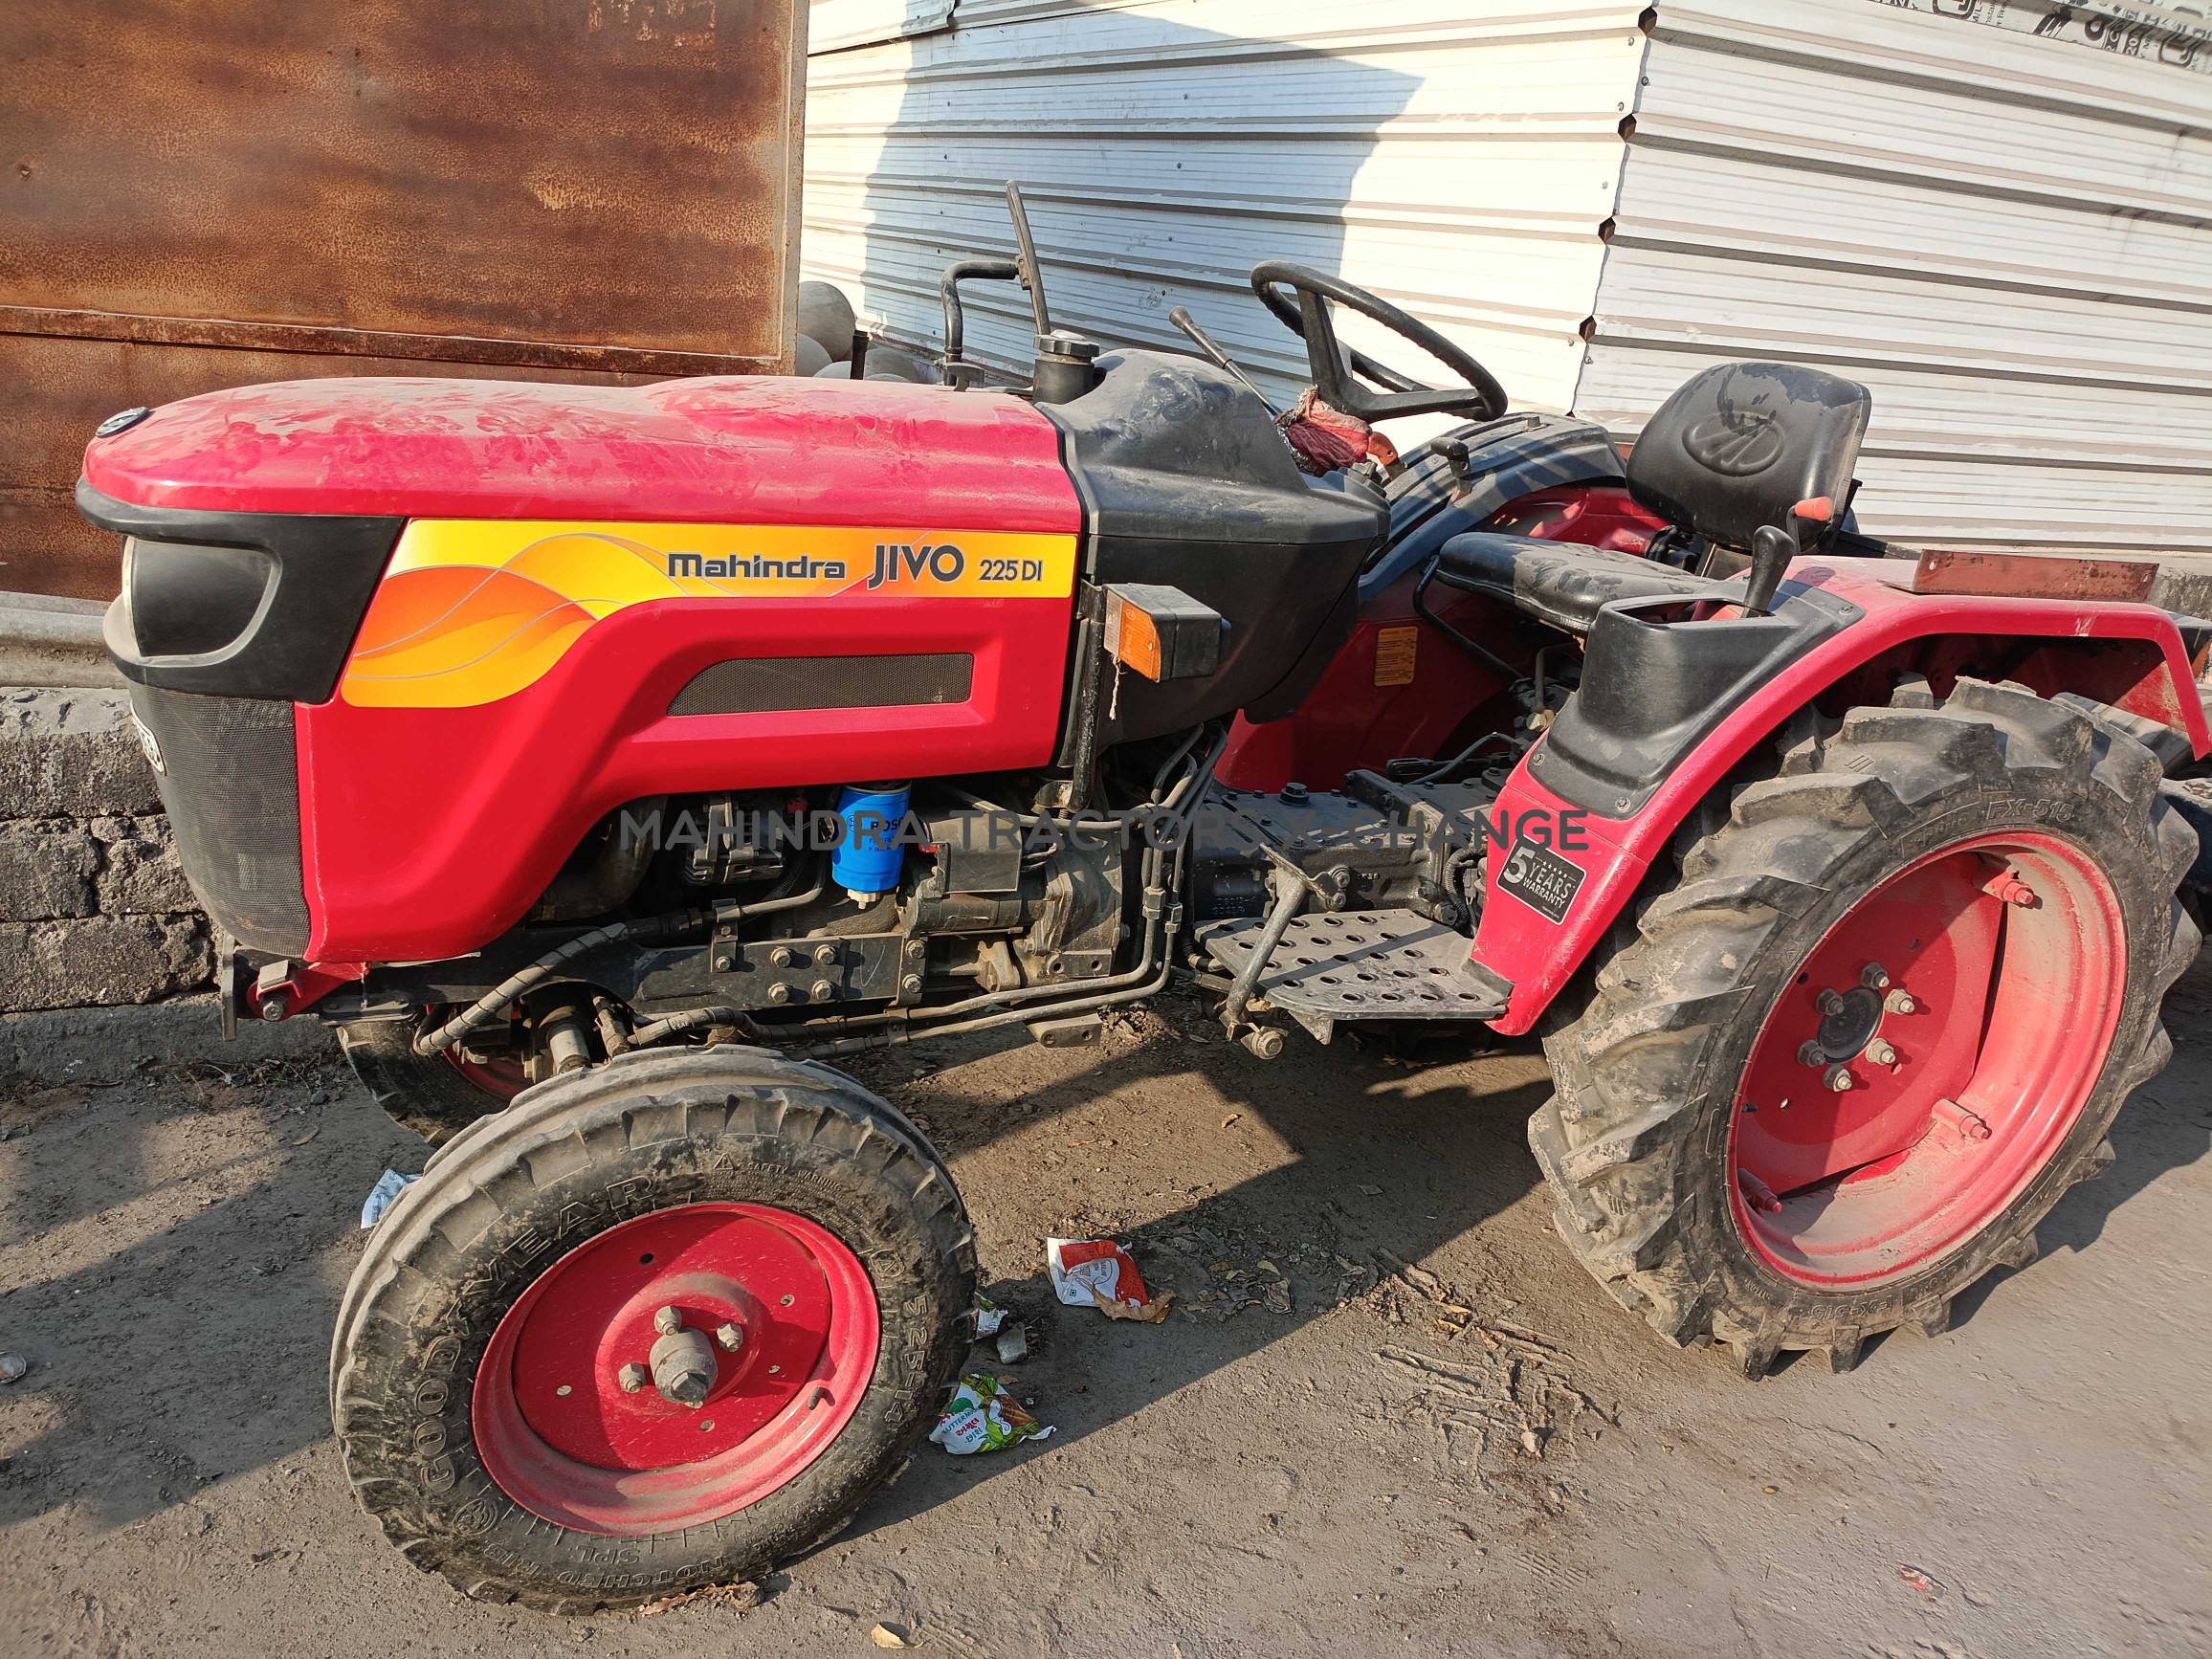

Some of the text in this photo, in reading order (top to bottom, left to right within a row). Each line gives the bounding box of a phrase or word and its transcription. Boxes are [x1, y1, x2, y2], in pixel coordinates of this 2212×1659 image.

[669, 552, 847, 579] Mahindra
[866, 543, 964, 590] JIVO
[1984, 798, 2074, 824] FX-515
[1503, 846, 1536, 884] 5
[1529, 861, 1572, 899] YEARS
[1522, 876, 1565, 909] WARRANTY
[747, 1161, 842, 1191] SAFETY WARNING
[1809, 1294, 1893, 1321] FX-515
[484, 1542, 727, 1589] NOTCHED RIB
